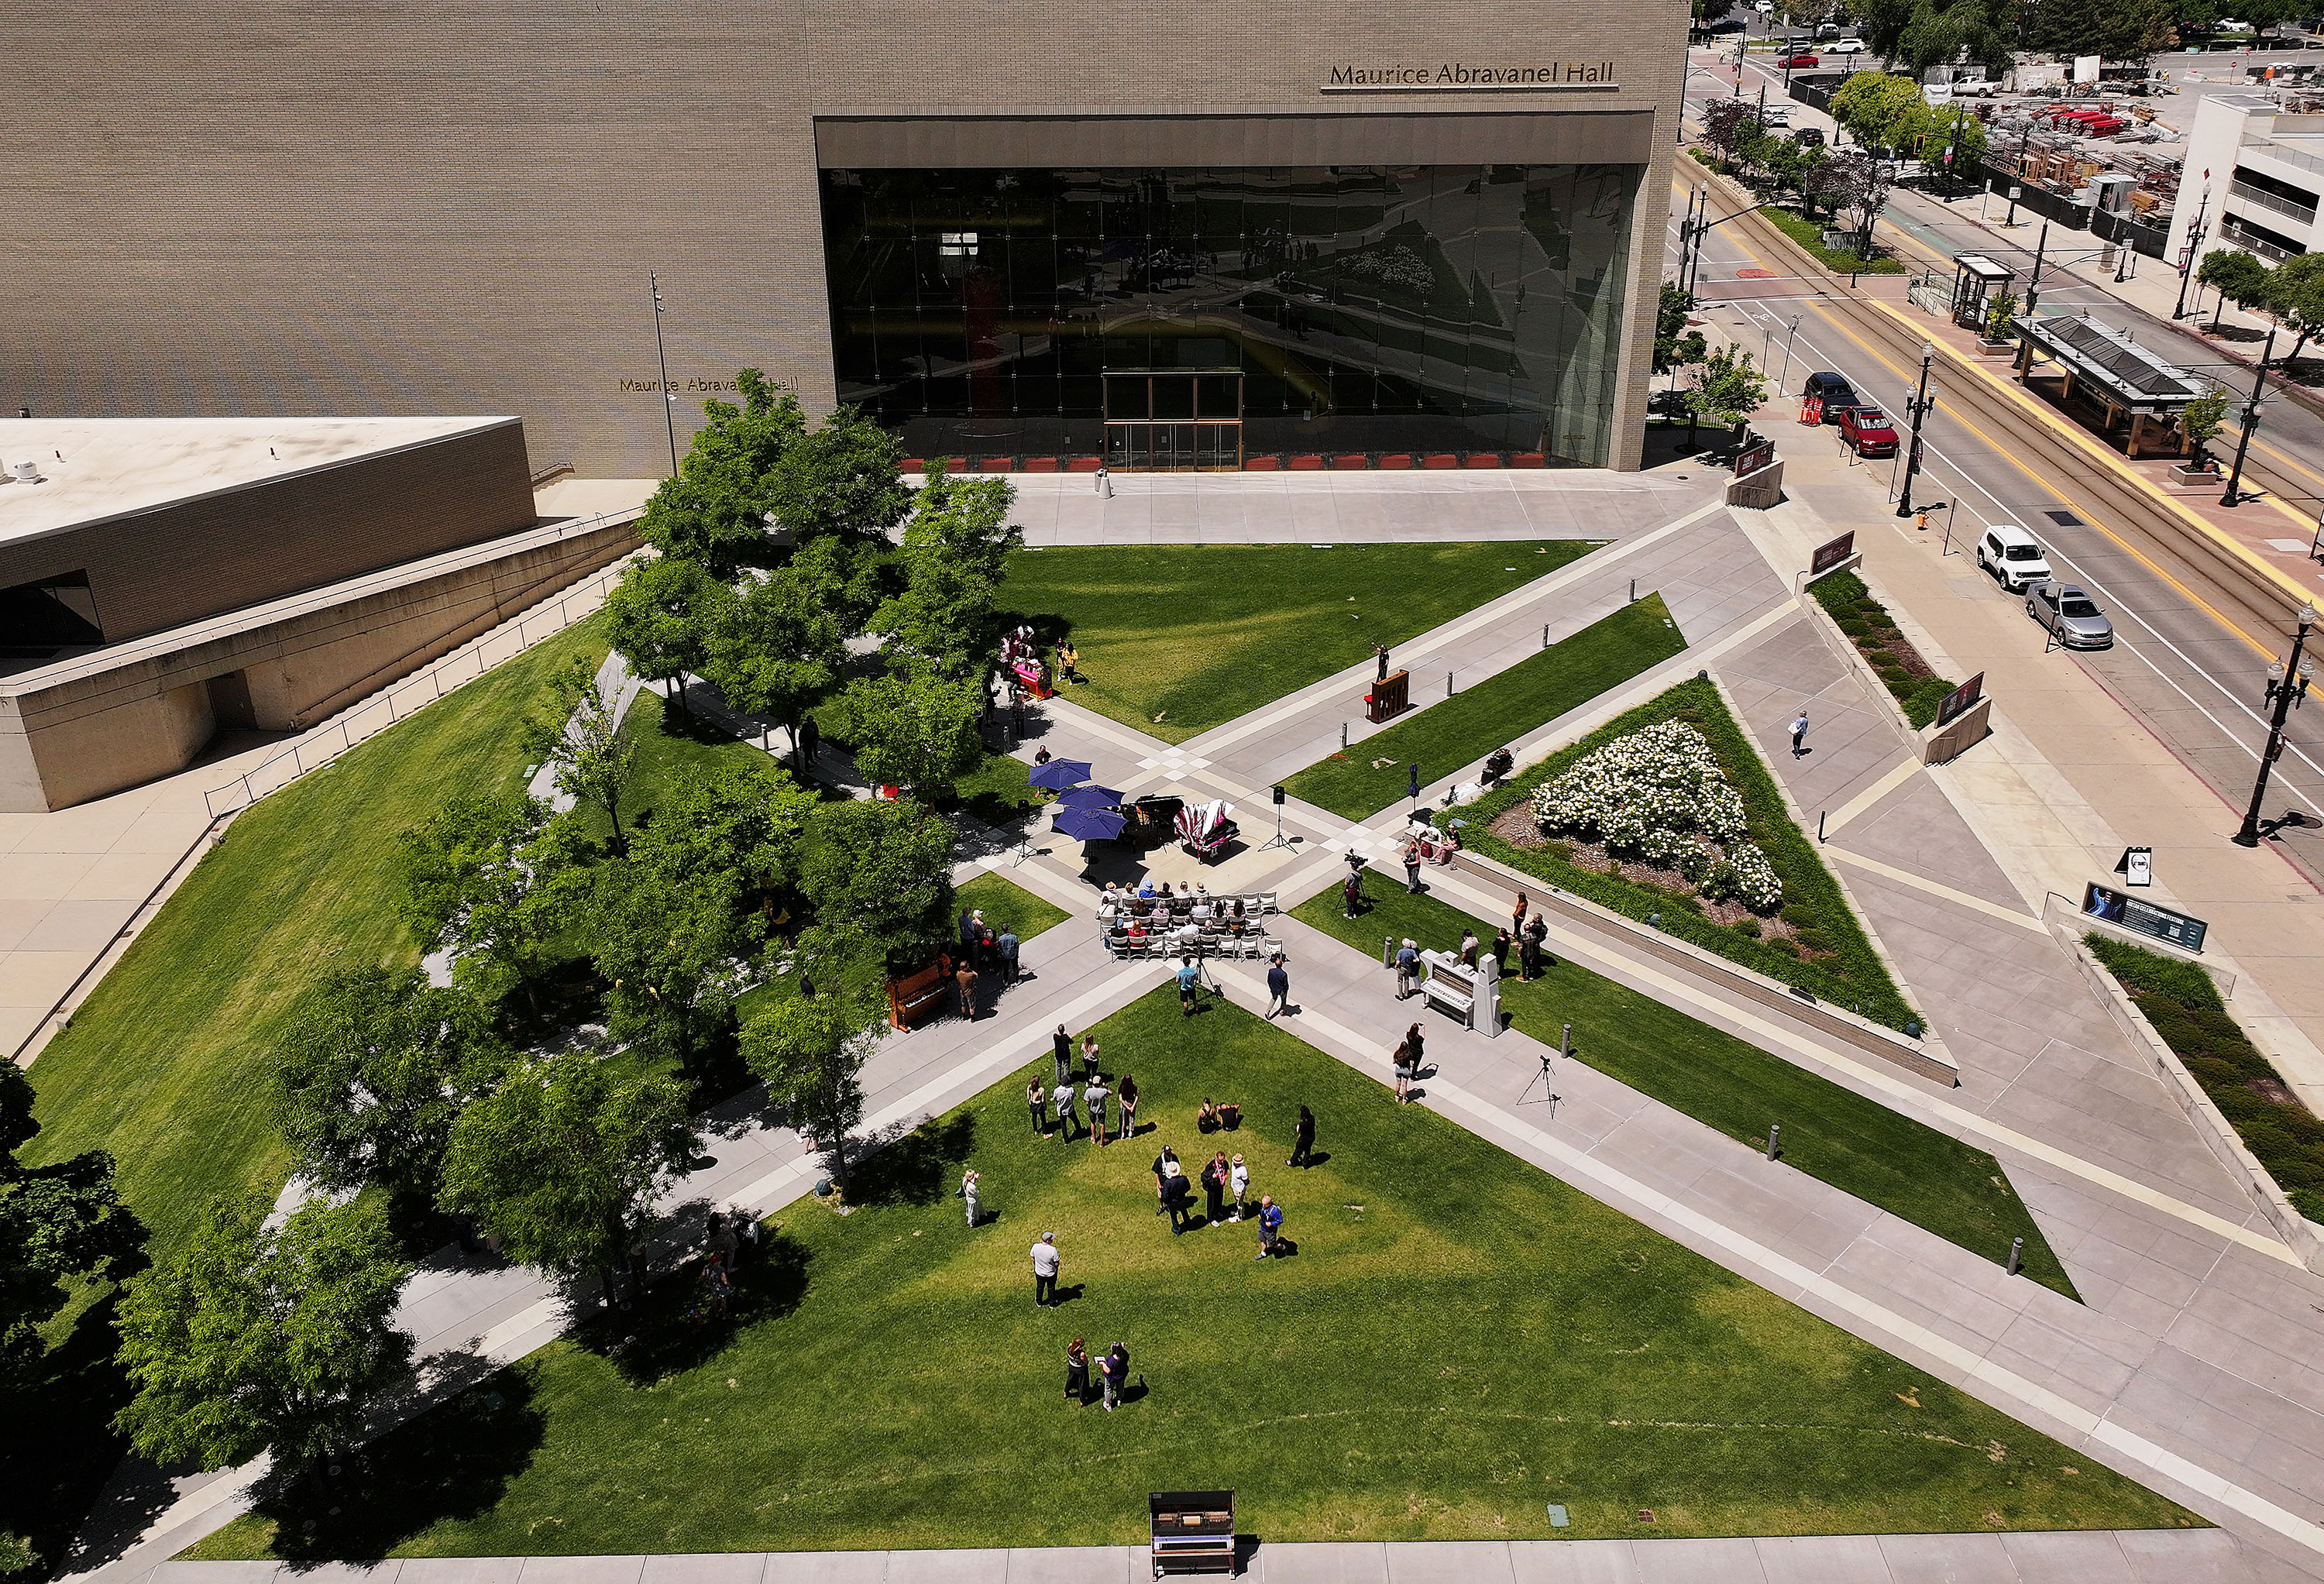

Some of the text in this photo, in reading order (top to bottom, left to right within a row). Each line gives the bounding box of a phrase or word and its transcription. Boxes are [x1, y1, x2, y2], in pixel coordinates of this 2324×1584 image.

[1330, 62, 1613, 84] Maurice Abravanel Hall
[687, 377, 740, 392] Abrava
